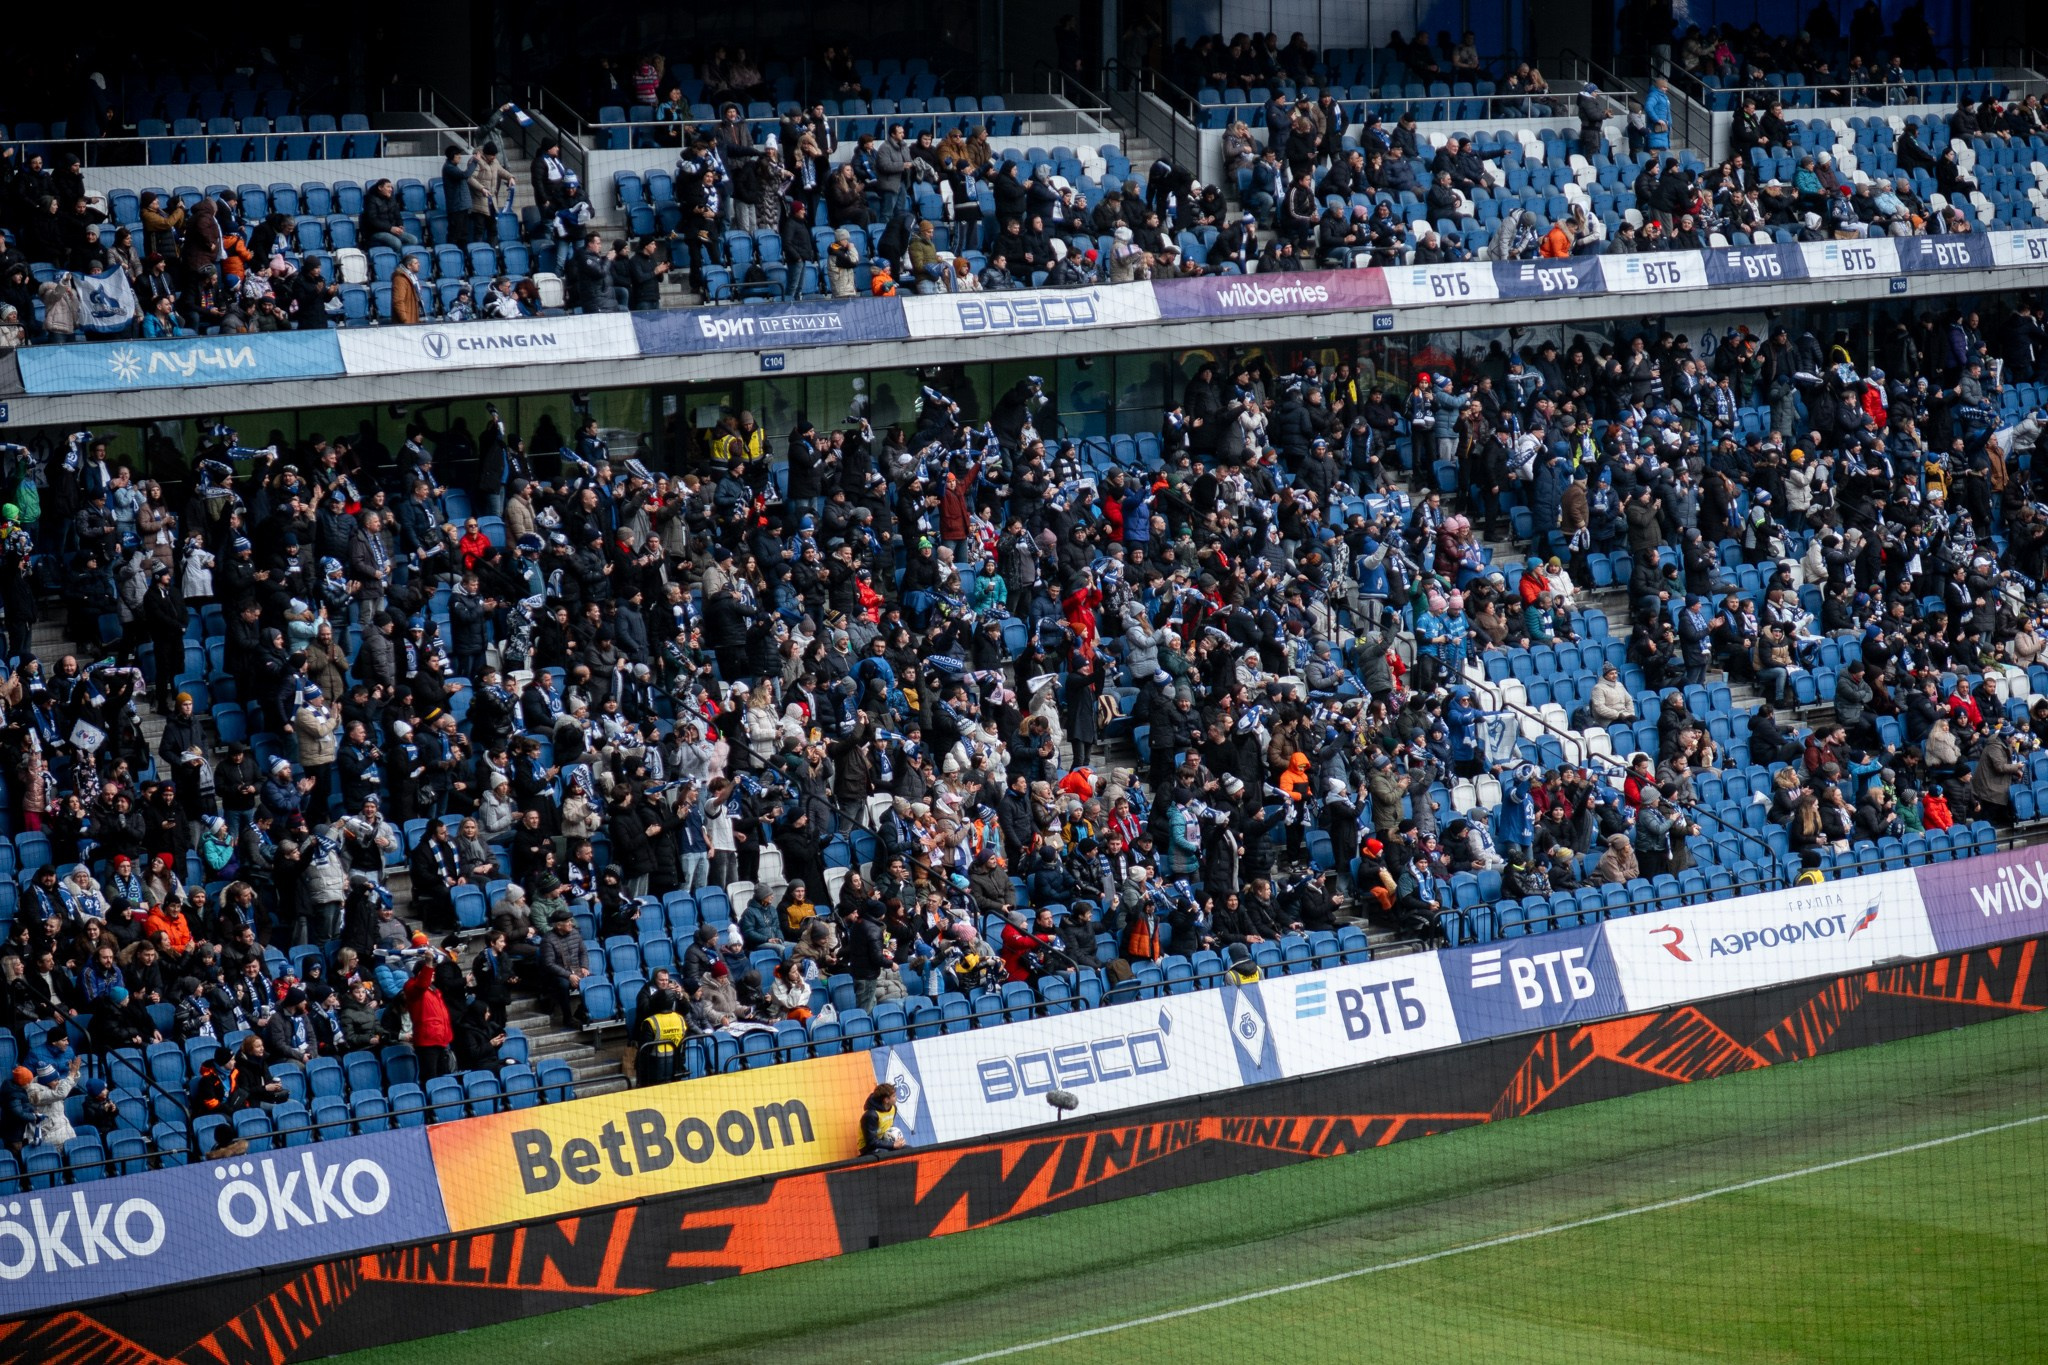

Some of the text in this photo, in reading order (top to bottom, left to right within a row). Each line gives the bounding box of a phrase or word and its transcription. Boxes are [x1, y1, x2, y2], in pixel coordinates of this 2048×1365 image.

[1743, 253, 1782, 278] ВТБ
[1842, 248, 1876, 271] ВТБ
[1934, 242, 1971, 266] ВТБ
[1430, 272, 1470, 297] ВТБ
[1537, 267, 1579, 291] ВТБ
[1642, 261, 1681, 285] ВТБ
[1217, 280, 1329, 307] wildberries
[956, 293, 1098, 331] BOSCO
[698, 314, 842, 342] Брит ПРЕМИУМ
[457, 333, 557, 351] CHANGAN
[1789, 893, 1843, 912] ГРУППА
[1710, 914, 1847, 958] АЭРОФЛОТ
[1509, 947, 1596, 1010] ВТБ
[1877, 938, 2048, 1011] WINLIN
[1336, 977, 1427, 1041] ВТБ
[977, 1028, 1171, 1104] BOSCO
[511, 1099, 815, 1195] BetBoom
